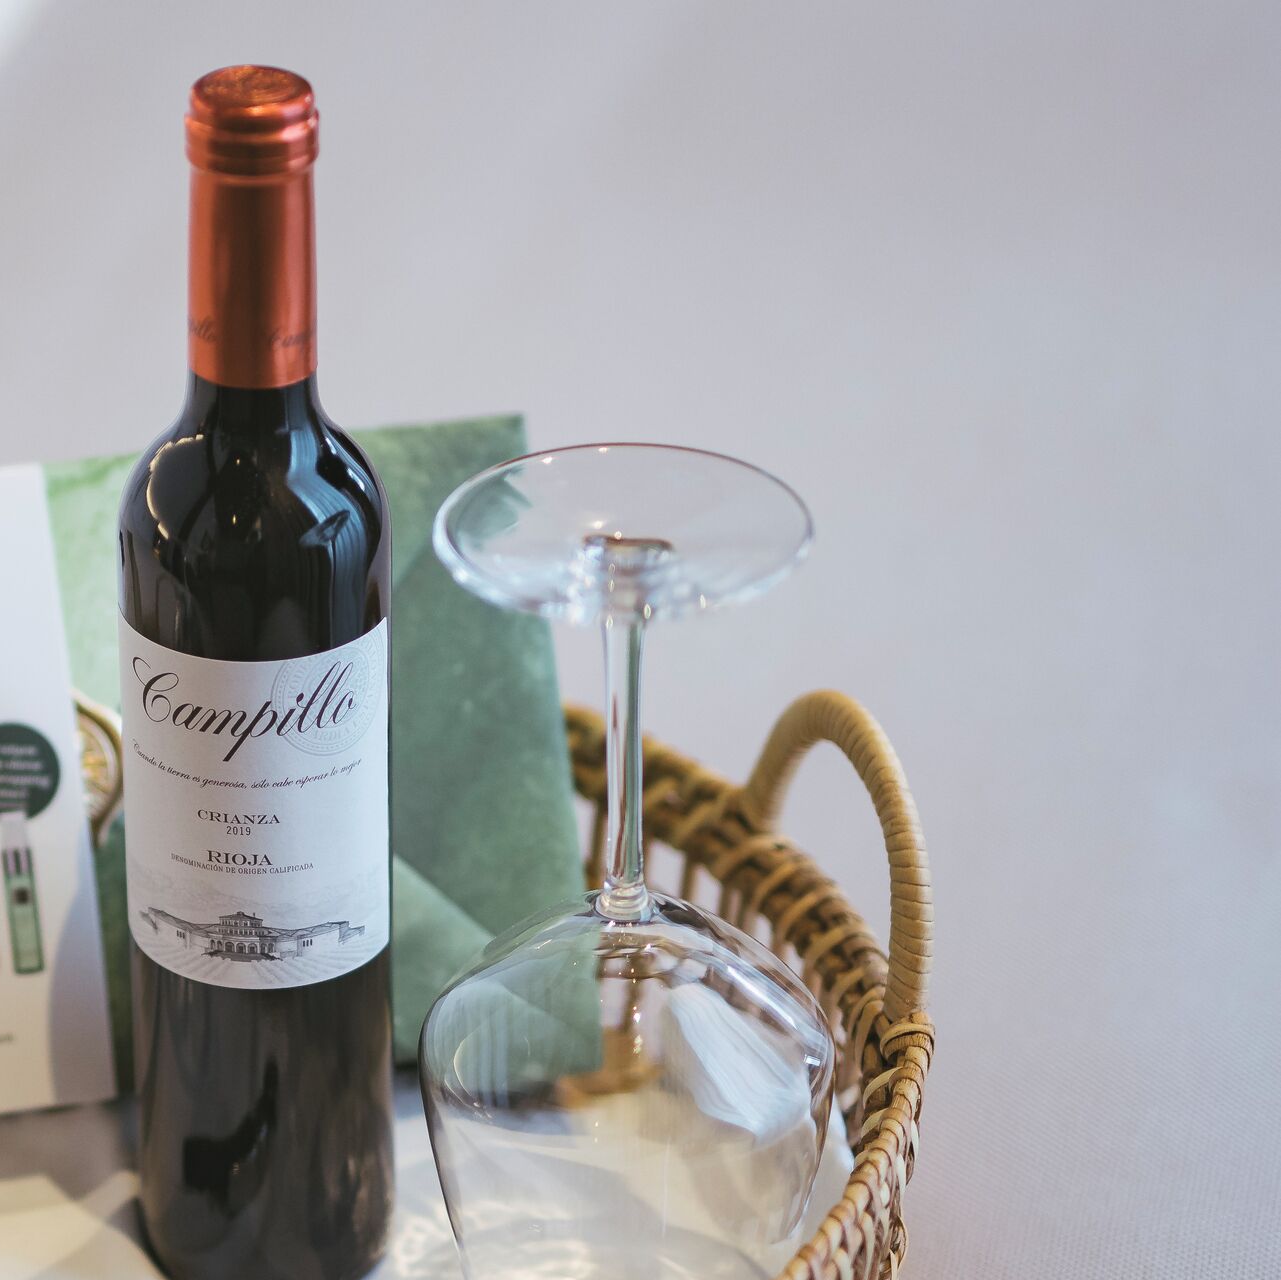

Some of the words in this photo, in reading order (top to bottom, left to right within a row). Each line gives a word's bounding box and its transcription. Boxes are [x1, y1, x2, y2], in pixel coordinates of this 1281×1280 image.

[132, 656, 357, 762] Campillo
[132, 738, 157, 767] Cuando
[158, 761, 166, 771] la
[166, 766, 191, 780] tierra
[192, 775, 201, 783] es
[272, 777, 294, 788] cabe
[295, 772, 329, 788] esperar
[330, 766, 338, 777] lo
[339, 758, 362, 776] mejor
[197, 808, 281, 825] CRIANZA
[226, 825, 251, 836] 2019
[171, 852, 224, 873] DENOMINACIÓN
[225, 866, 236, 874] DE
[238, 867, 267, 875] ORIGEN
[269, 862, 314, 874] CALIFICADA
[206, 849, 273, 866] RIOJA
